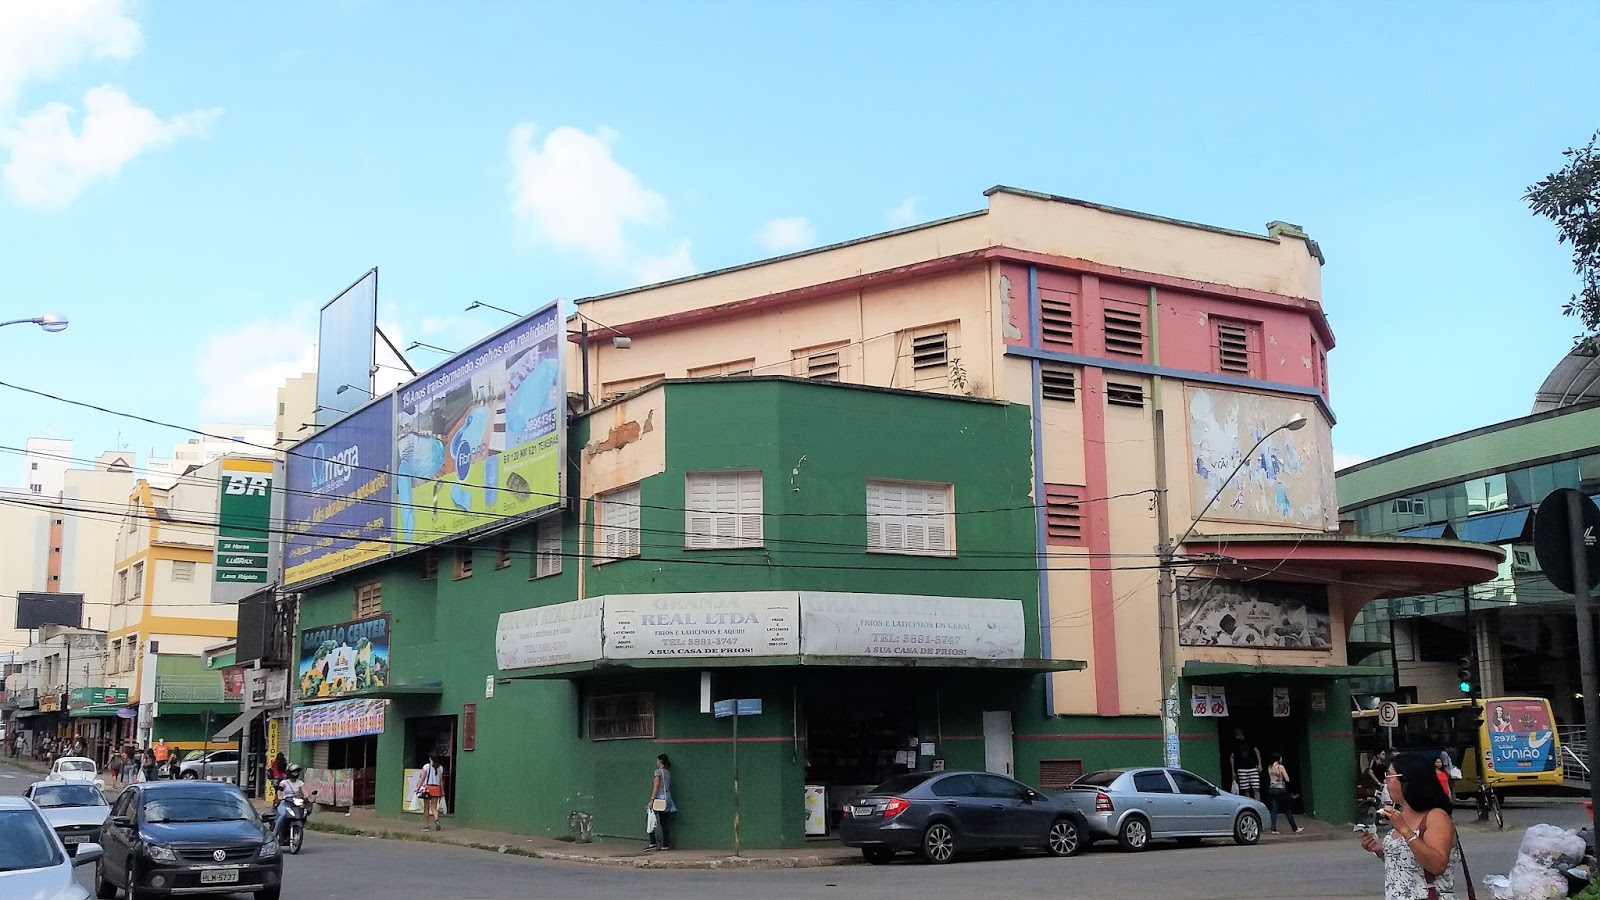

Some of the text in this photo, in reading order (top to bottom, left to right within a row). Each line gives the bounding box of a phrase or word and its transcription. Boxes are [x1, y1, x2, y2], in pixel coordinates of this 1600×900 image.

[409, 383, 426, 404] Anos
[426, 359, 475, 395] transformando
[474, 343, 502, 370] sonhos
[502, 340, 517, 354] em
[516, 314, 558, 347] realidade!
[224, 474, 269, 496] BR
[225, 557, 254, 565] LUBRAX
[653, 597, 740, 610] GRANJA
[641, 612, 760, 626] REAL LTDA
[860, 619, 883, 627] FRIOS
[947, 622, 972, 630] GERAL
[304, 618, 386, 650] SACOLÃO CENTER
[871, 633, 900, 643] TEL:
[662, 638, 686, 646] TEL:
[934, 648, 967, 656] FRIOS!
[1385, 706, 1391, 719] E
[1494, 734, 1517, 742] 2975
[1502, 747, 1540, 759] UNIÃO
